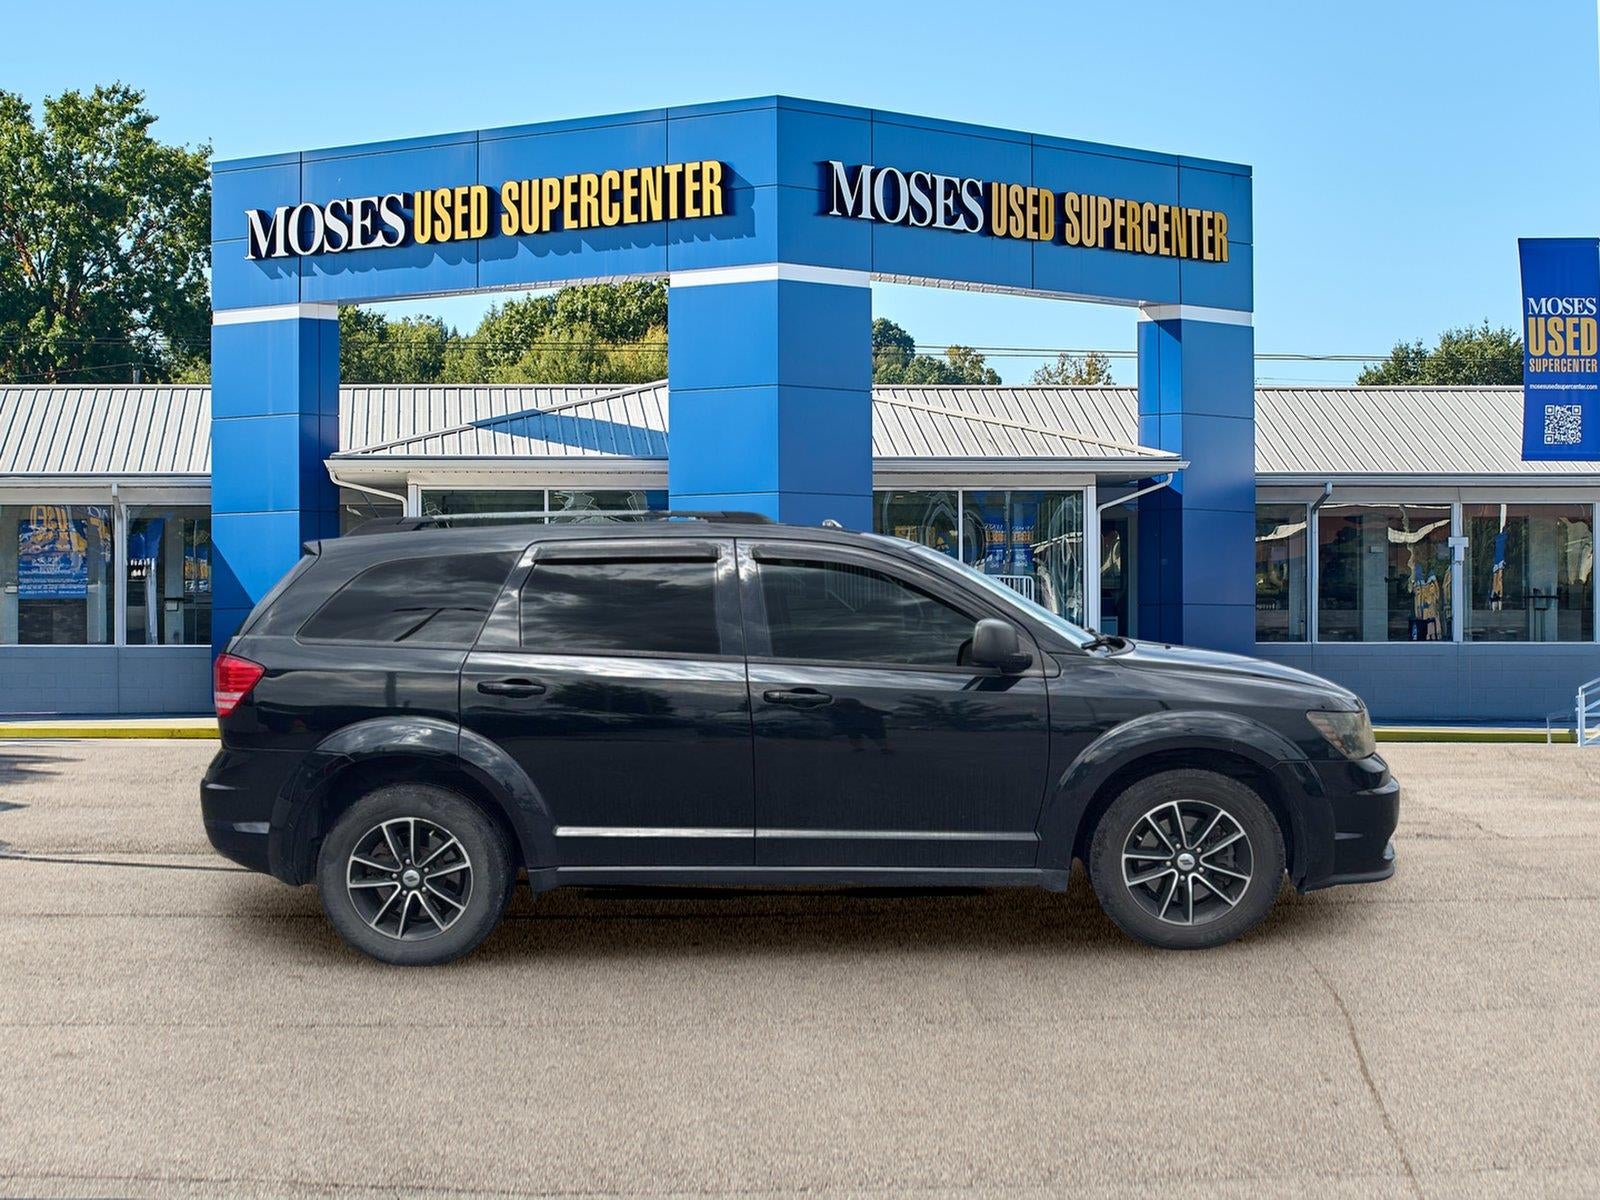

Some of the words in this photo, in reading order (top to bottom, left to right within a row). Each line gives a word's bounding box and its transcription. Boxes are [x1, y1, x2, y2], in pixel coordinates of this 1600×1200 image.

[244, 193, 406, 261] MOSES
[413, 185, 489, 245] USED
[500, 160, 724, 237] SUPERCENTER
[828, 160, 985, 233] MOSES
[991, 181, 1055, 241] USED
[1065, 191, 1229, 263] SUPERCENTER
[1528, 297, 1597, 315] MOSES
[1528, 317, 1597, 356] USED
[1529, 358, 1597, 372] SUPERCENTER
